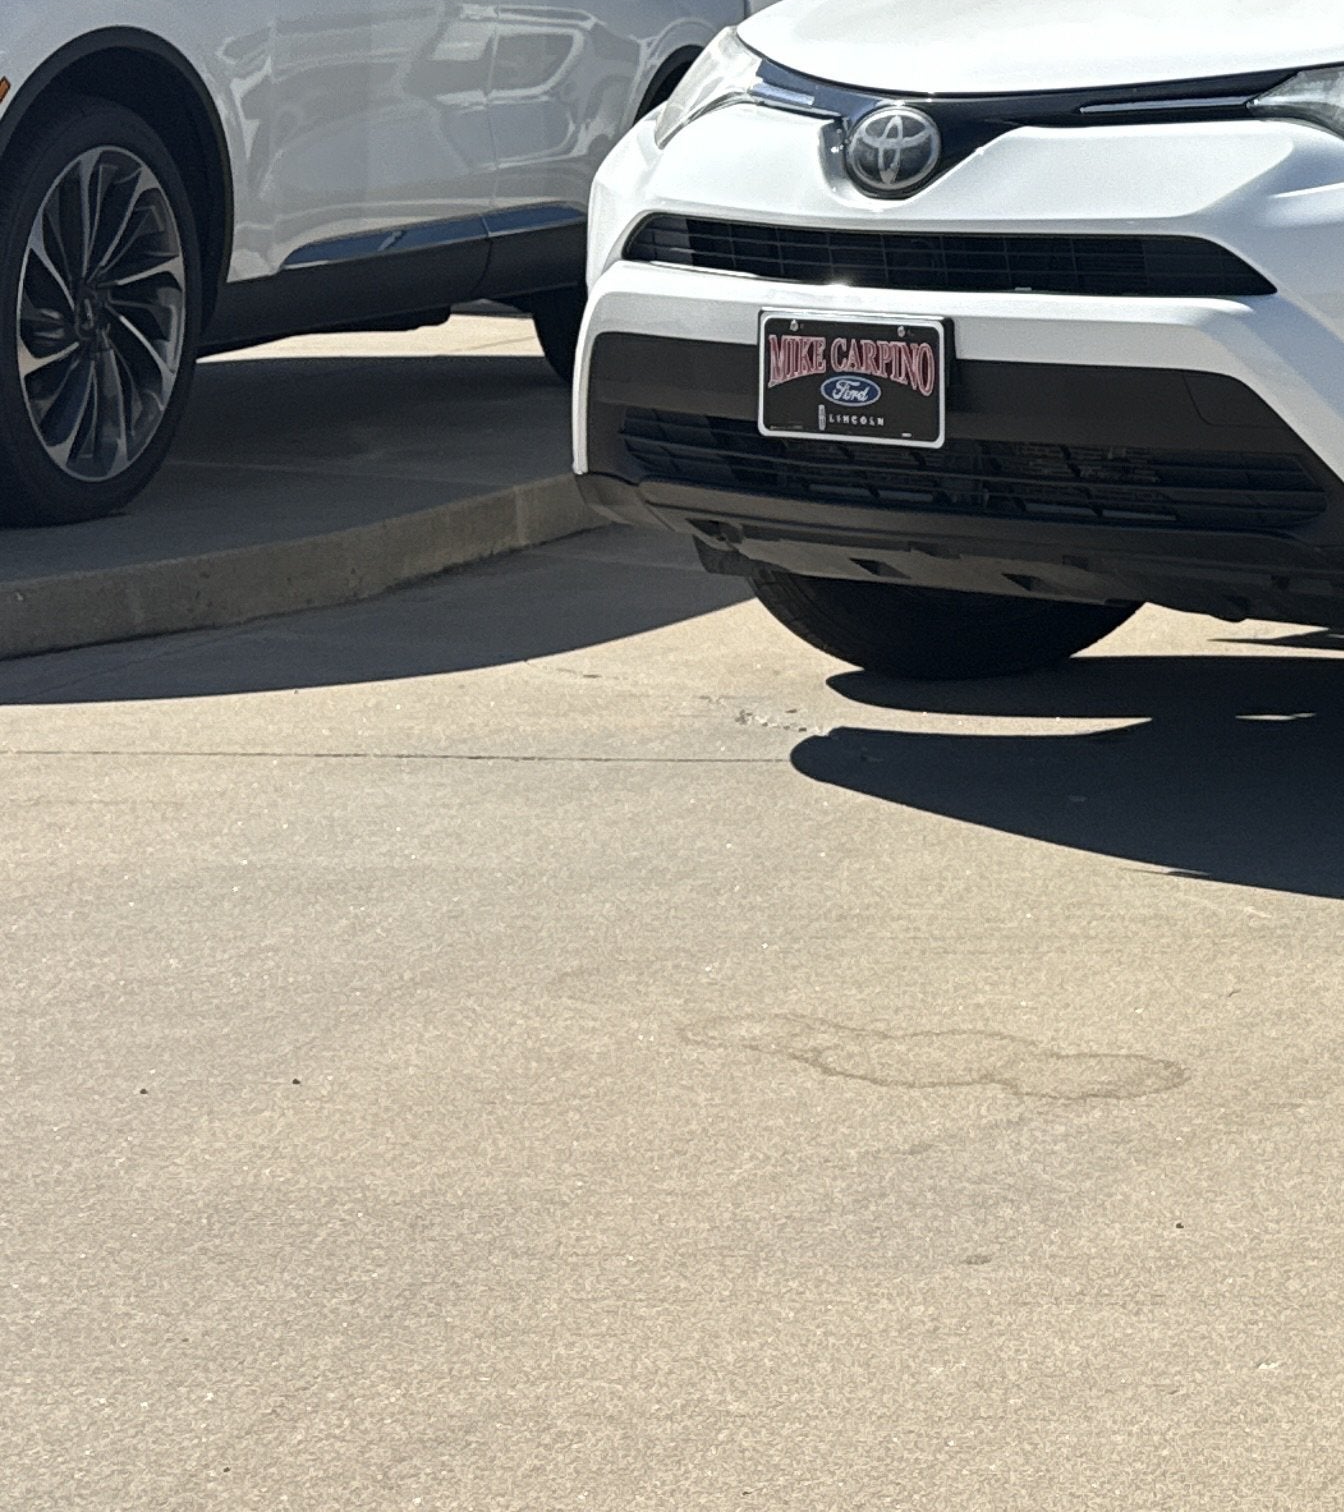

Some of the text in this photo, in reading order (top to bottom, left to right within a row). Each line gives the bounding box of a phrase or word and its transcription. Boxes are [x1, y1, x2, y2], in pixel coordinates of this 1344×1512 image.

[767, 334, 935, 397] MIKE CARPINO
[831, 380, 869, 402] Ford
[828, 414, 884, 426] LINCOLN
